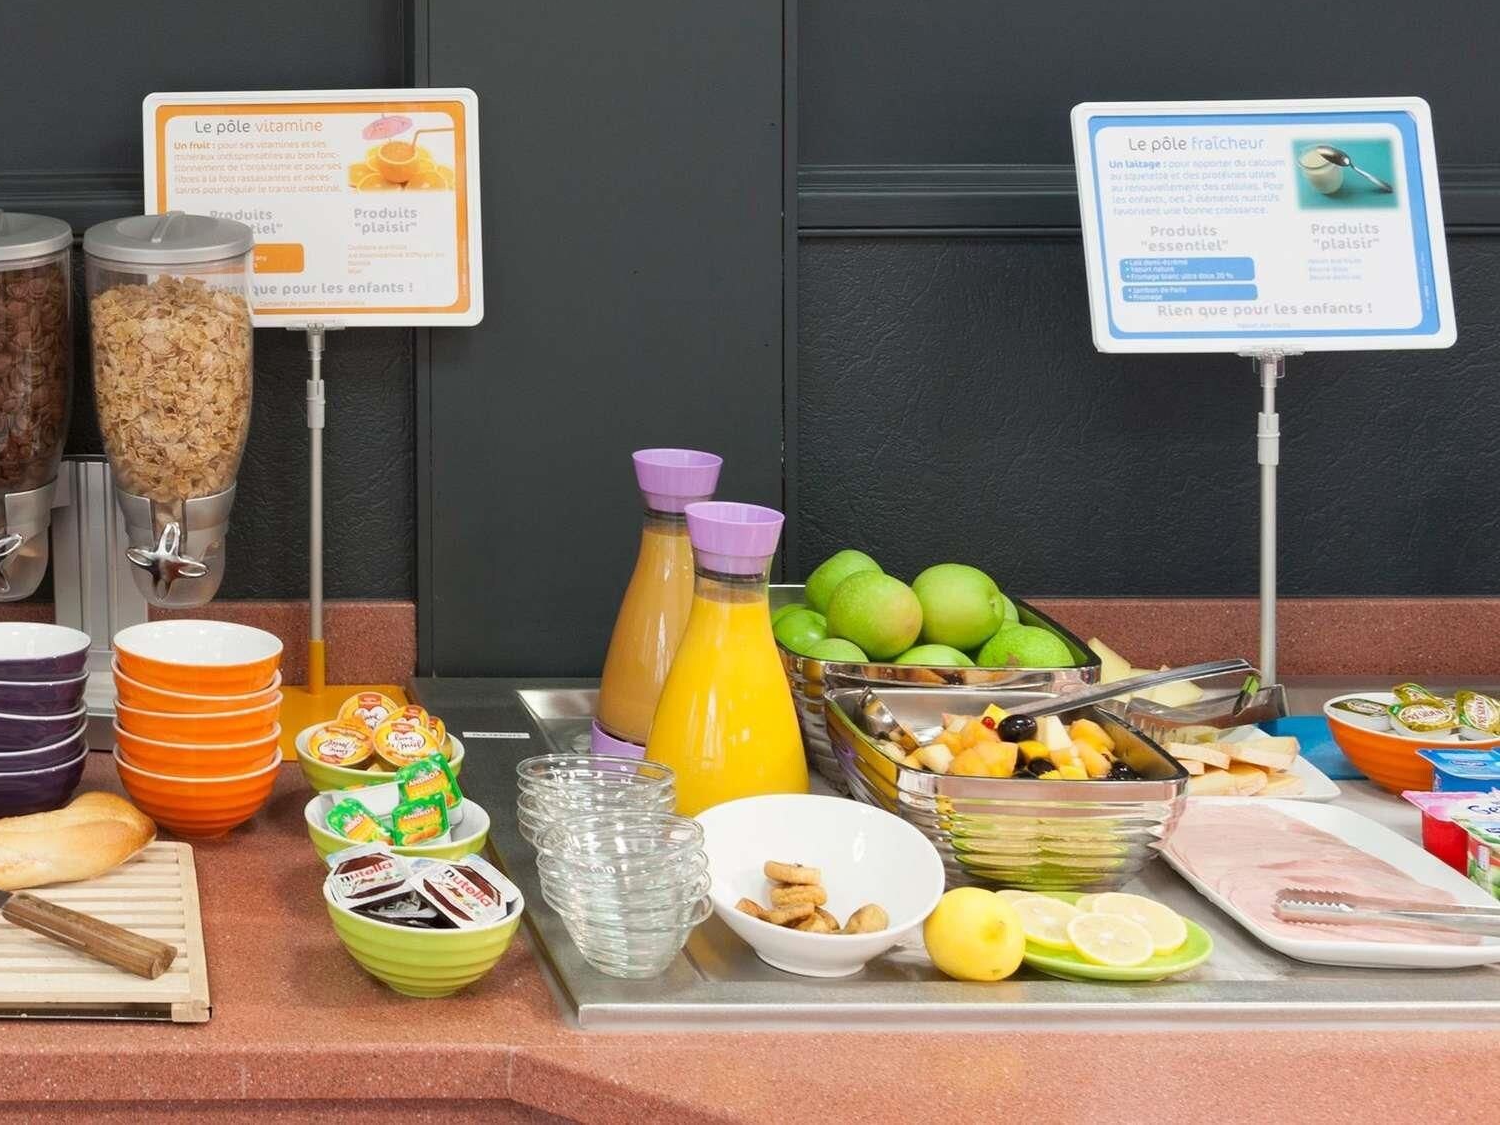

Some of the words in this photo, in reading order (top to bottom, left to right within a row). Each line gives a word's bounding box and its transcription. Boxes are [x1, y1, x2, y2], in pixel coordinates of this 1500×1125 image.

[195, 120, 211, 133] Le
[217, 120, 251, 135] pôle
[256, 119, 324, 133] vitamine
[173, 142, 188, 150] Un
[189, 141, 211, 150] fruit
[217, 142, 238, 151] pour
[239, 141, 254, 149] ses
[256, 140, 299, 149] vitamines
[300, 140, 310, 148] et
[1128, 137, 1147, 151] Le
[1151, 136, 1187, 152] pôle
[1191, 136, 1265, 150] fraîcheur
[298, 150, 315, 159] bon
[228, 163, 239, 171] de
[293, 162, 303, 170] et
[304, 162, 323, 172] pour
[325, 162, 342, 170] ses
[1124, 160, 1161, 170] laitage
[1169, 161, 1190, 170] pour
[1234, 159, 1246, 167] du
[293, 174, 303, 182] et
[202, 187, 223, 196] pour
[258, 185, 267, 194] le
[354, 207, 418, 219] Produits
[354, 221, 418, 234] "plaisir"
[1149, 224, 1218, 237] Produits
[1311, 223, 1379, 235] Produits
[1140, 239, 1228, 252] "essentiel"
[1312, 237, 1380, 251] "plaisir"
[282, 282, 318, 296] pour
[321, 281, 344, 294] les
[348, 281, 405, 294] enfants
[1158, 305, 1193, 316] Rien
[1199, 306, 1228, 318] que
[1234, 305, 1271, 317] pour
[1274, 303, 1297, 315] les
[1302, 301, 1363, 315] enfants
[339, 861, 394, 883] nutella
[444, 868, 493, 908] nutella
